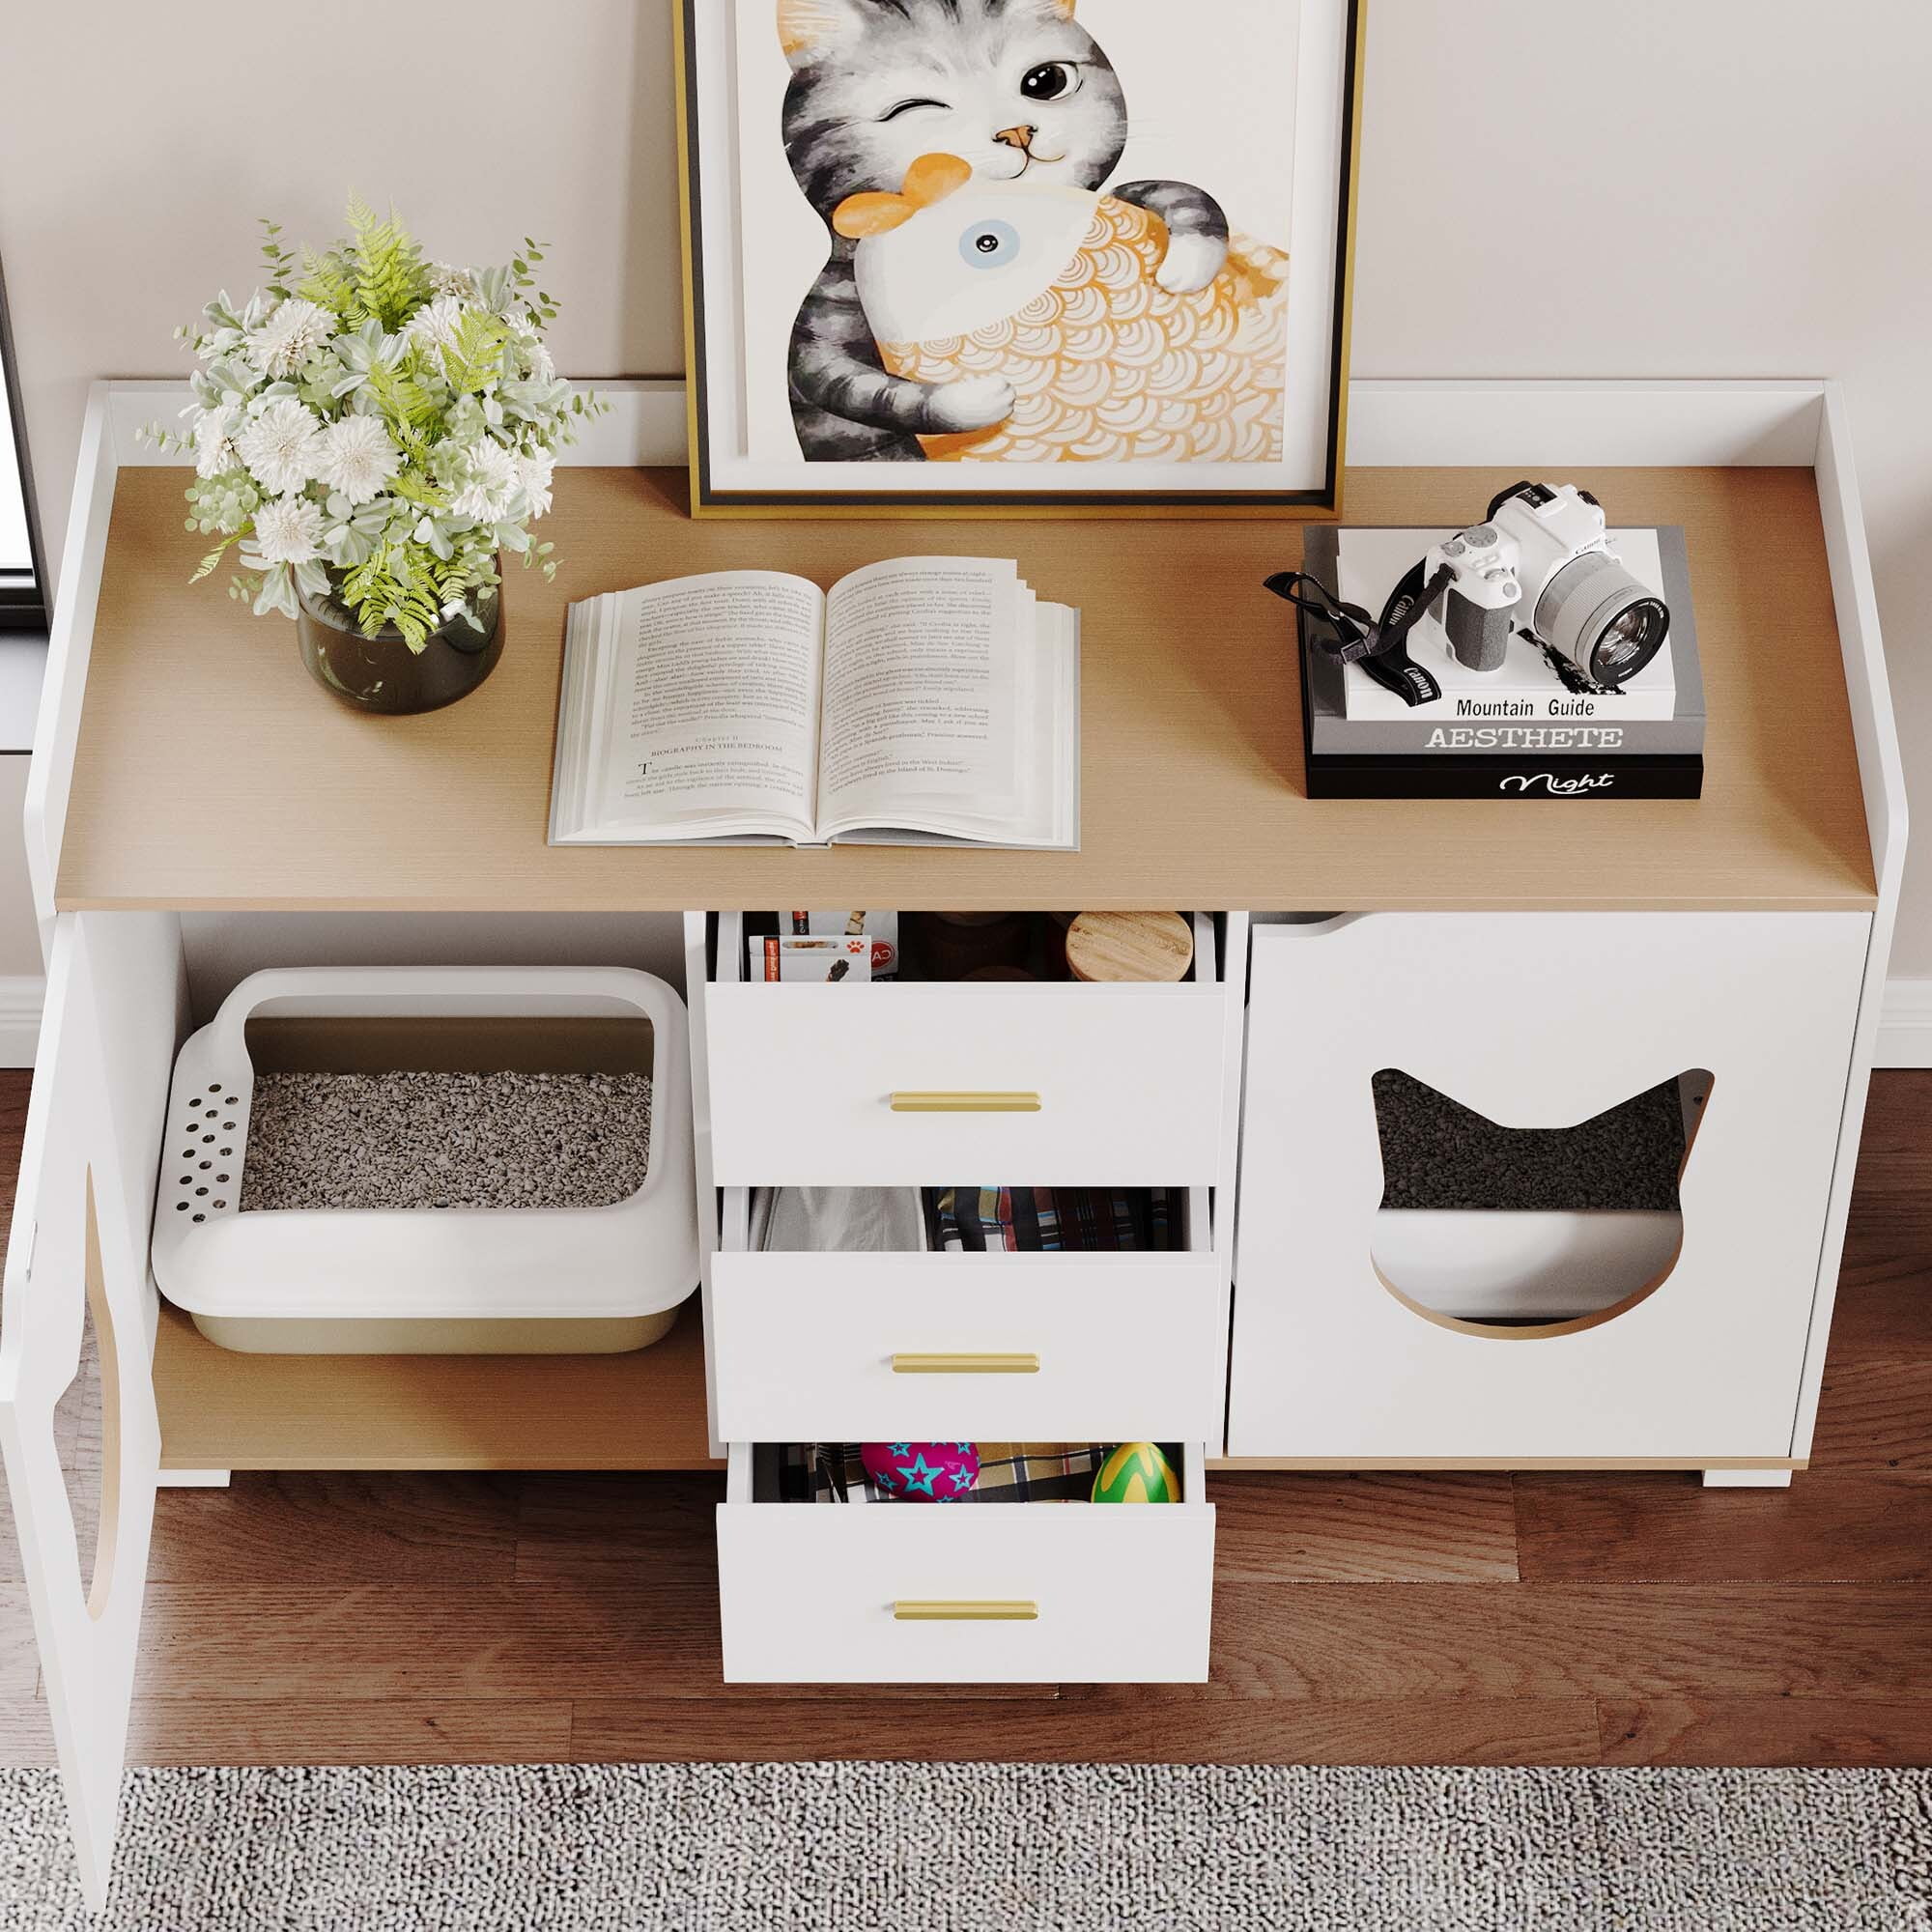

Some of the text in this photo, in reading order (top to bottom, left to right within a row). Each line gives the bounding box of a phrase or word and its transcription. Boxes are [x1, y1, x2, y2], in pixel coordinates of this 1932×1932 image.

[1404, 668, 1434, 698] Canon
[1456, 699, 1595, 717] Mountain Guide
[1425, 727, 1624, 749] AESTHETE
[651, 743, 703, 757] BIOGRAPHY
[705, 743, 715, 752] IN
[1499, 773, 1615, 795] Night
